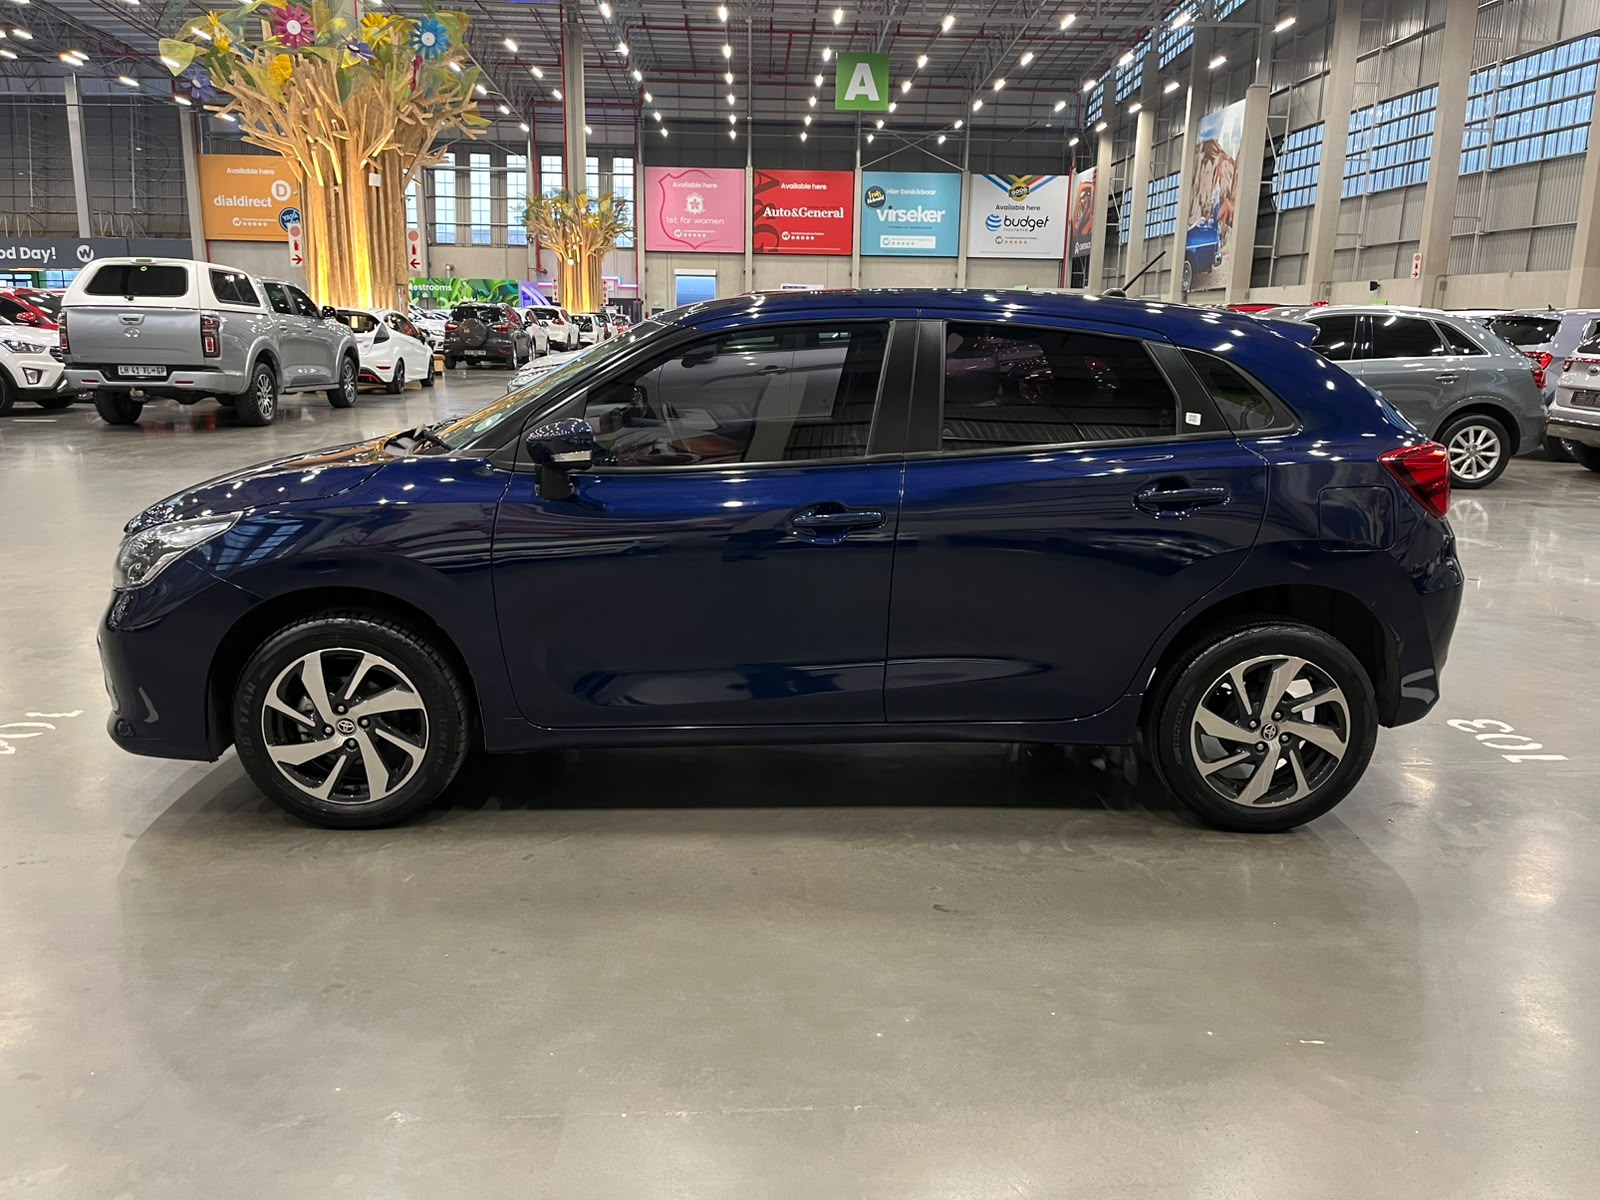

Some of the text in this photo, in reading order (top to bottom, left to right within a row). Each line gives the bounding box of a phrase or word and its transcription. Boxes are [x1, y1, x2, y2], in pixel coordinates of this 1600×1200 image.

[844, 62, 880, 102] A
[226, 167, 258, 175] Available
[781, 183, 827, 191] Available here
[900, 188, 937, 196] beskikbaar
[213, 194, 273, 208] dialdirect
[763, 206, 845, 218] Auto&General
[876, 205, 946, 223] virseker
[665, 216, 677, 224] 1st
[680, 216, 692, 224] for
[1003, 215, 1049, 232] budget
[19, 246, 57, 264] Day!
